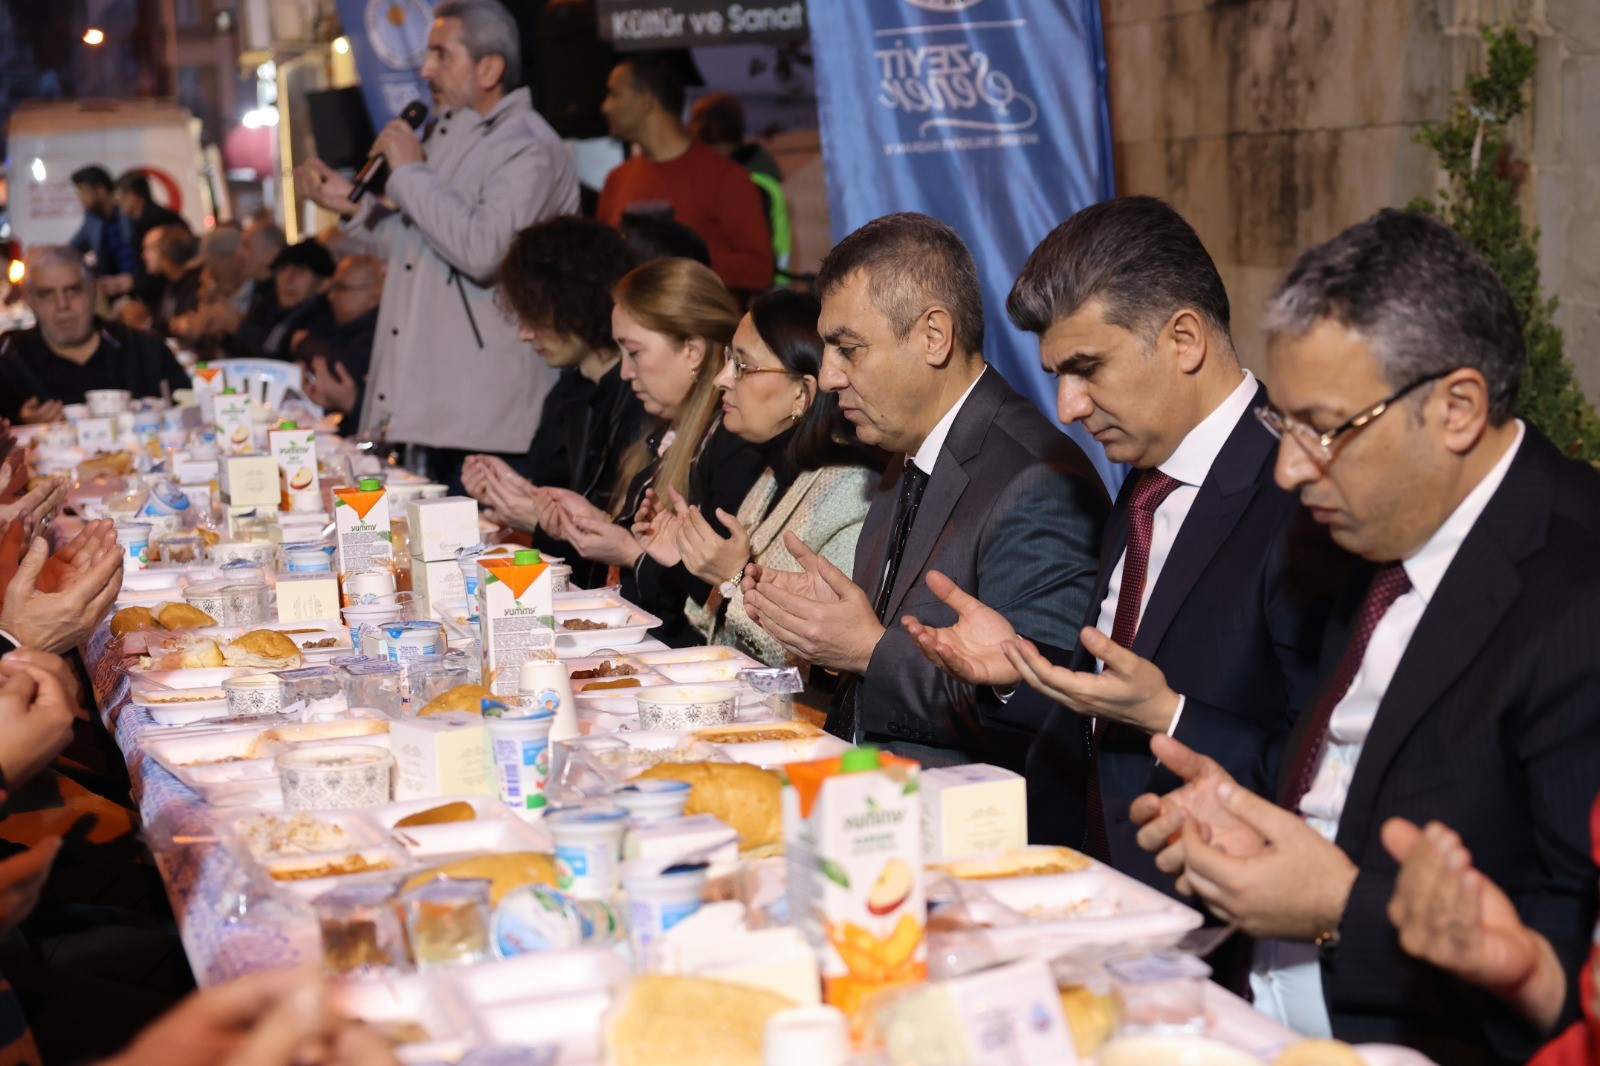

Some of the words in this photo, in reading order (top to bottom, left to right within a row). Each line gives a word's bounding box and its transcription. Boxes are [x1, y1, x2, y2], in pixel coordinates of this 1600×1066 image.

[611, 7, 685, 39] Kültür
[688, 11, 724, 34] ve
[351, 524, 377, 532] yummy
[504, 607, 536, 616] yummy
